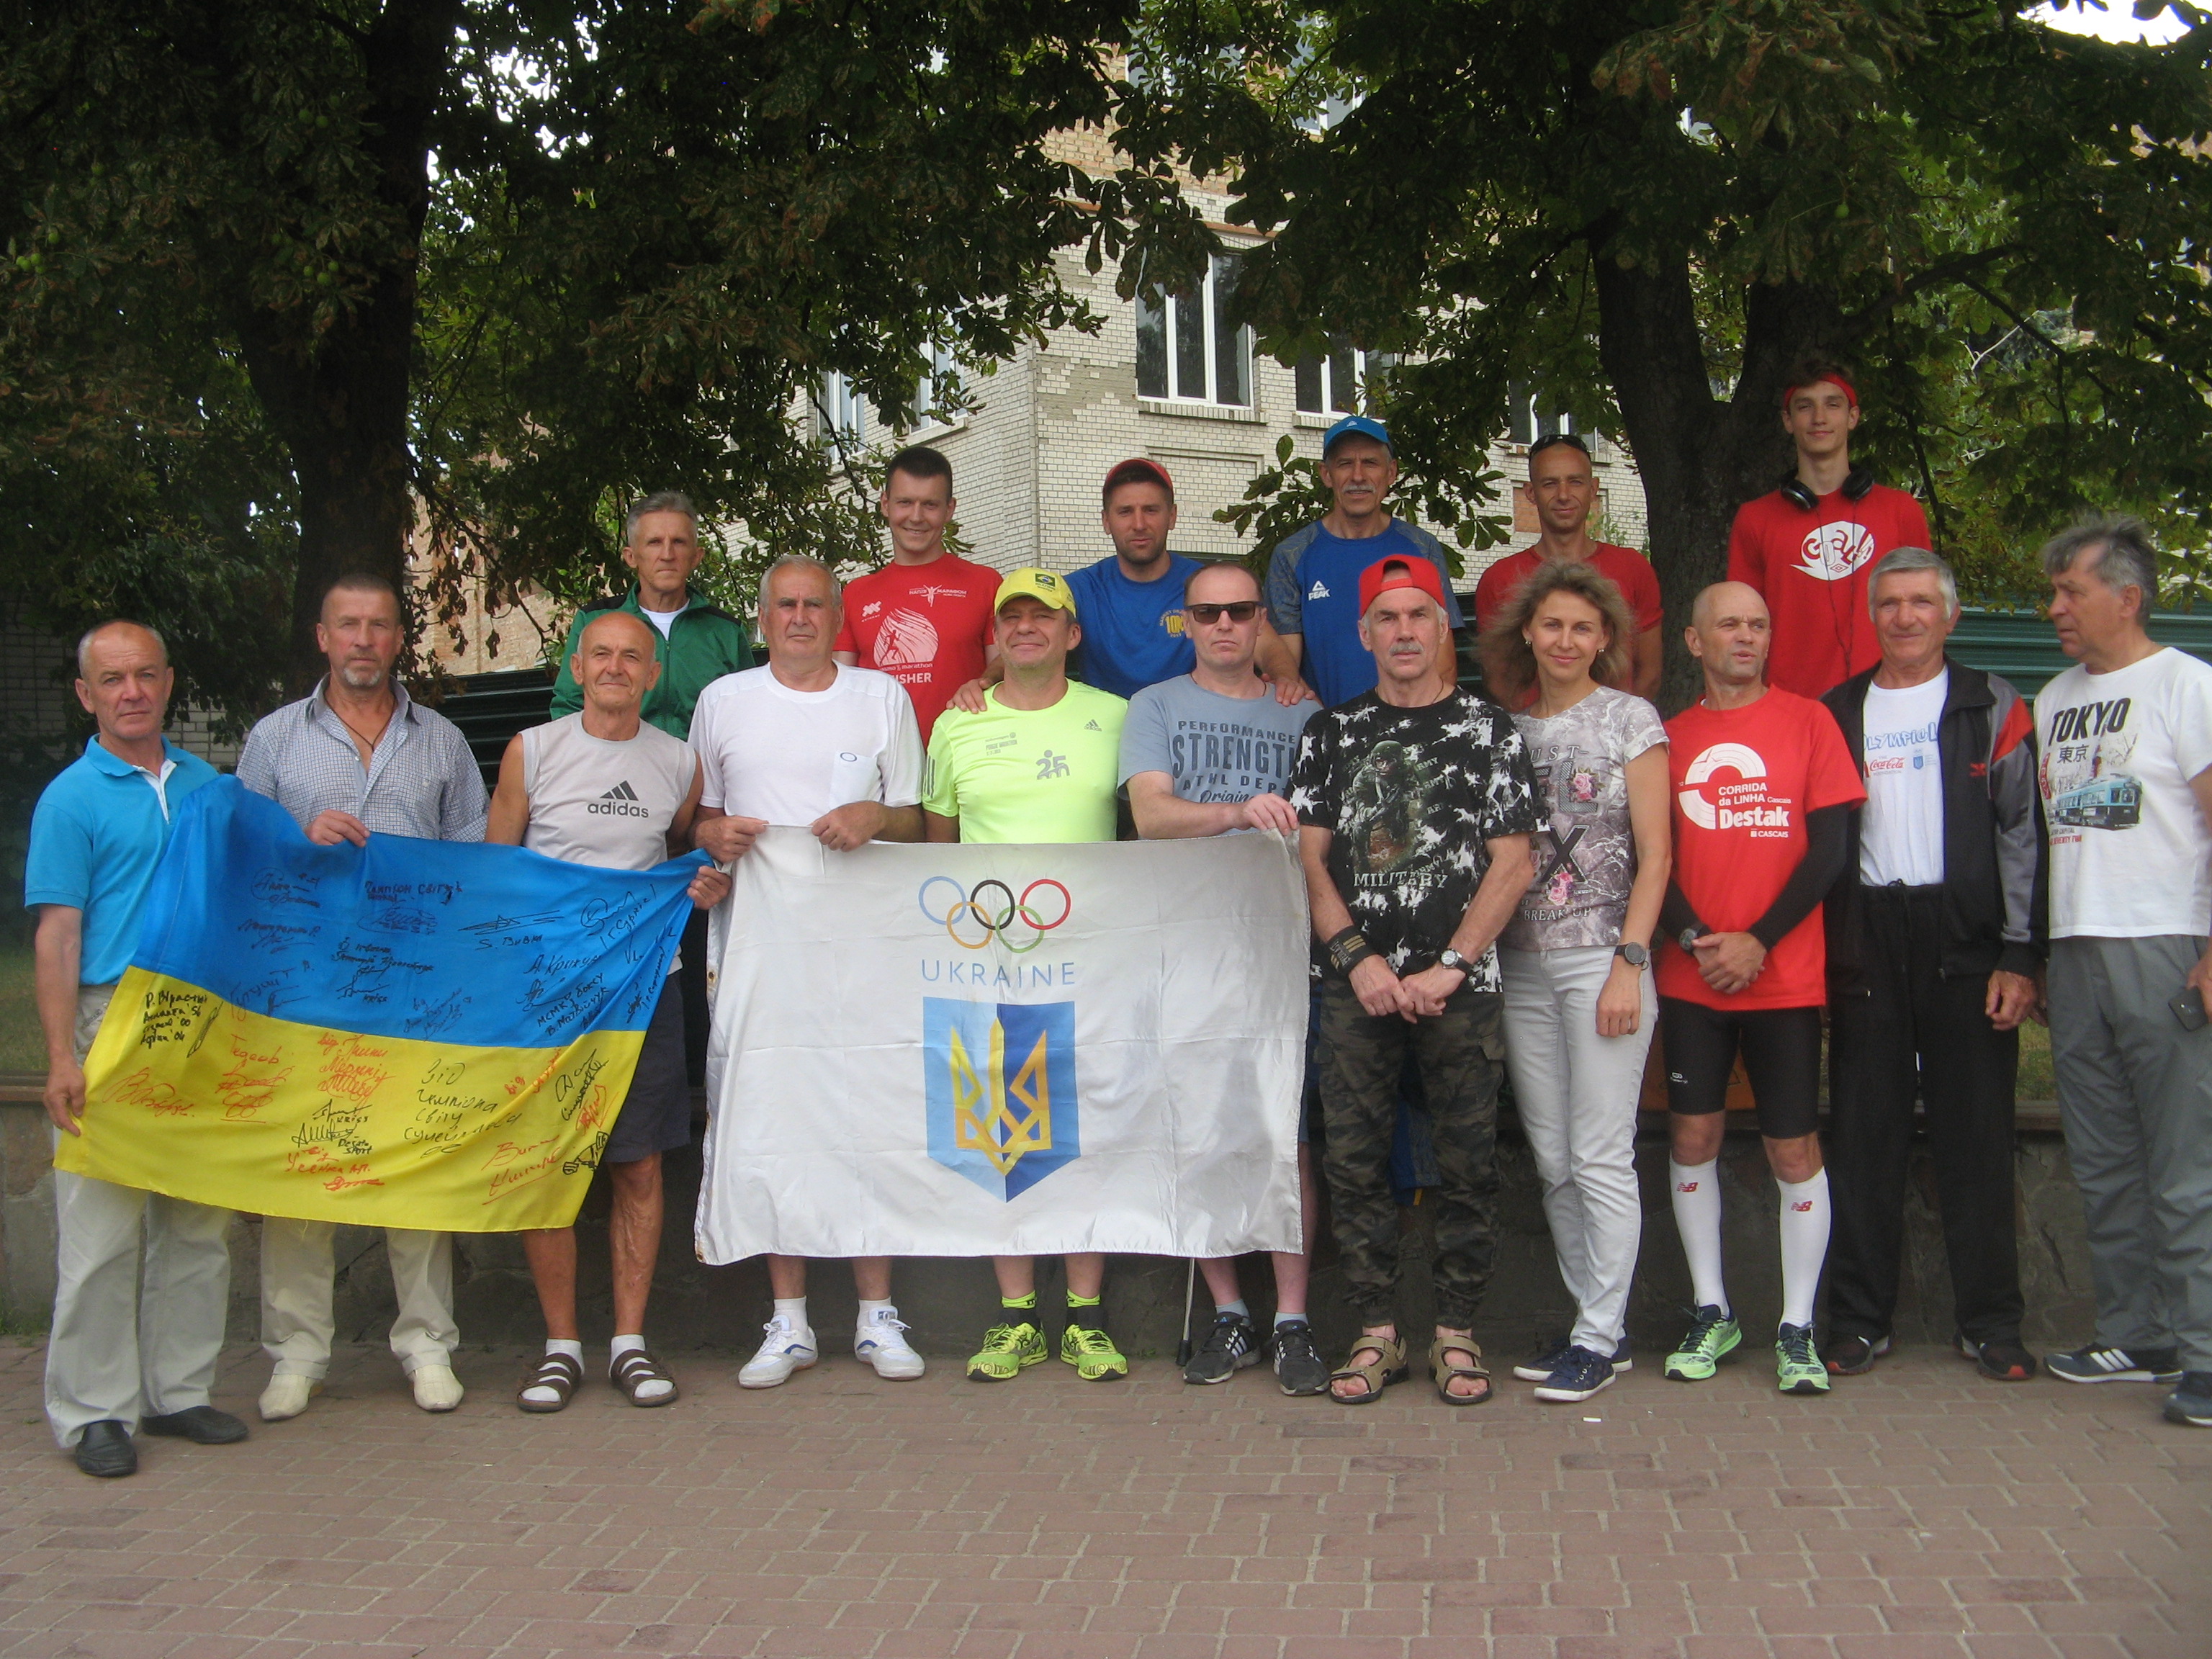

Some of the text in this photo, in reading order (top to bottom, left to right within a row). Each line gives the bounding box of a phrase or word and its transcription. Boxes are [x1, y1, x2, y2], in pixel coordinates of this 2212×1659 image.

[1308, 588, 1331, 601] PEAK
[895, 672, 932, 684] ISHER
[2048, 697, 2131, 747] TOKYO
[1178, 721, 1295, 744] PERFORMANCE
[2057, 743, 2090, 764] 東京
[1183, 773, 1228, 791] ATHL
[1718, 782, 1768, 796] CORRIDA
[1718, 797, 1731, 806] da
[1734, 793, 1765, 805] LINHA
[587, 801, 649, 818] adidas
[1719, 806, 1789, 830] Destak
[1354, 871, 1449, 890] MILITARY
[1524, 907, 1592, 921] BREAK UP
[922, 959, 1075, 988] UKRAINE
